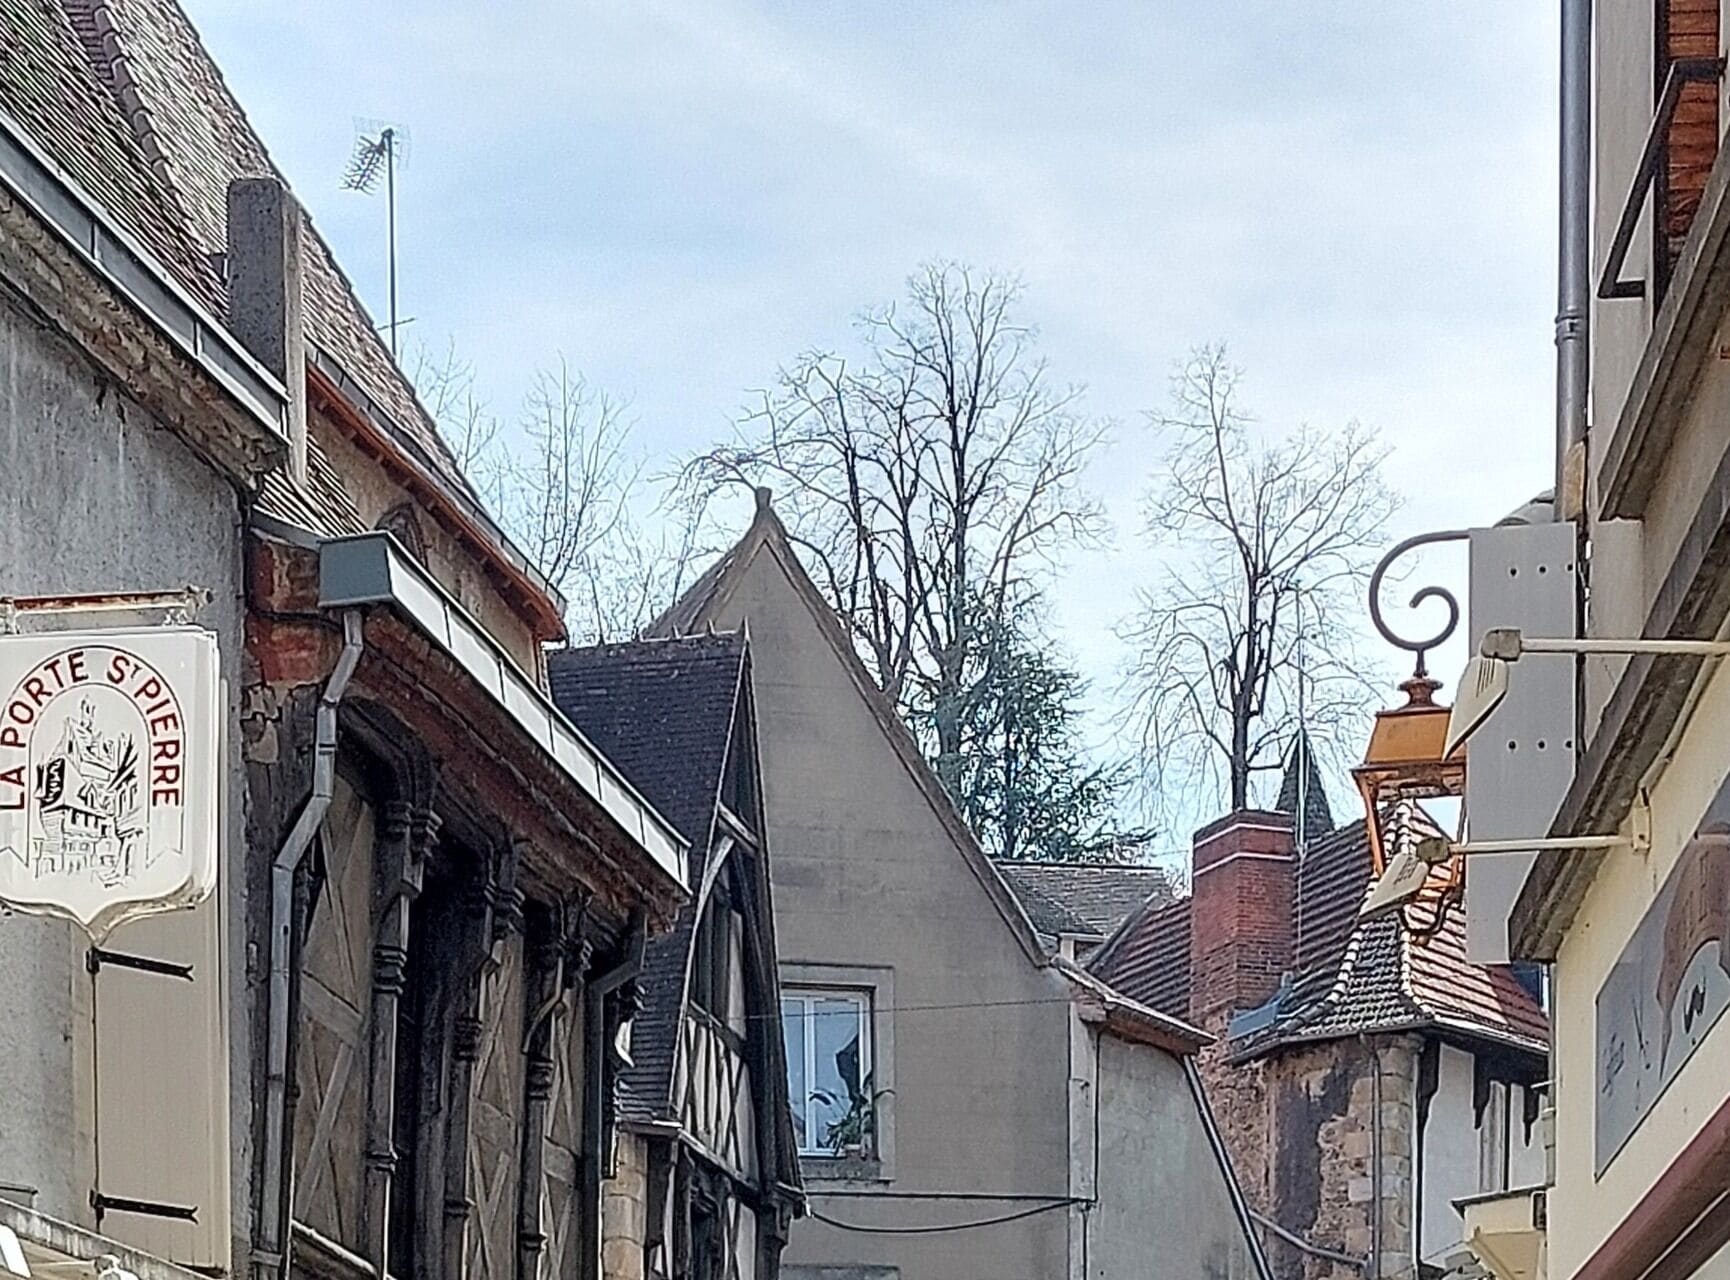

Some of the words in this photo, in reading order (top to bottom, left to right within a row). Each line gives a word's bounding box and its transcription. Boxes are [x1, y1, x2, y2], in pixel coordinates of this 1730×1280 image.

[0, 651, 89, 748] PORTE
[133, 675, 181, 808] PIERRE
[0, 765, 26, 810] LA
